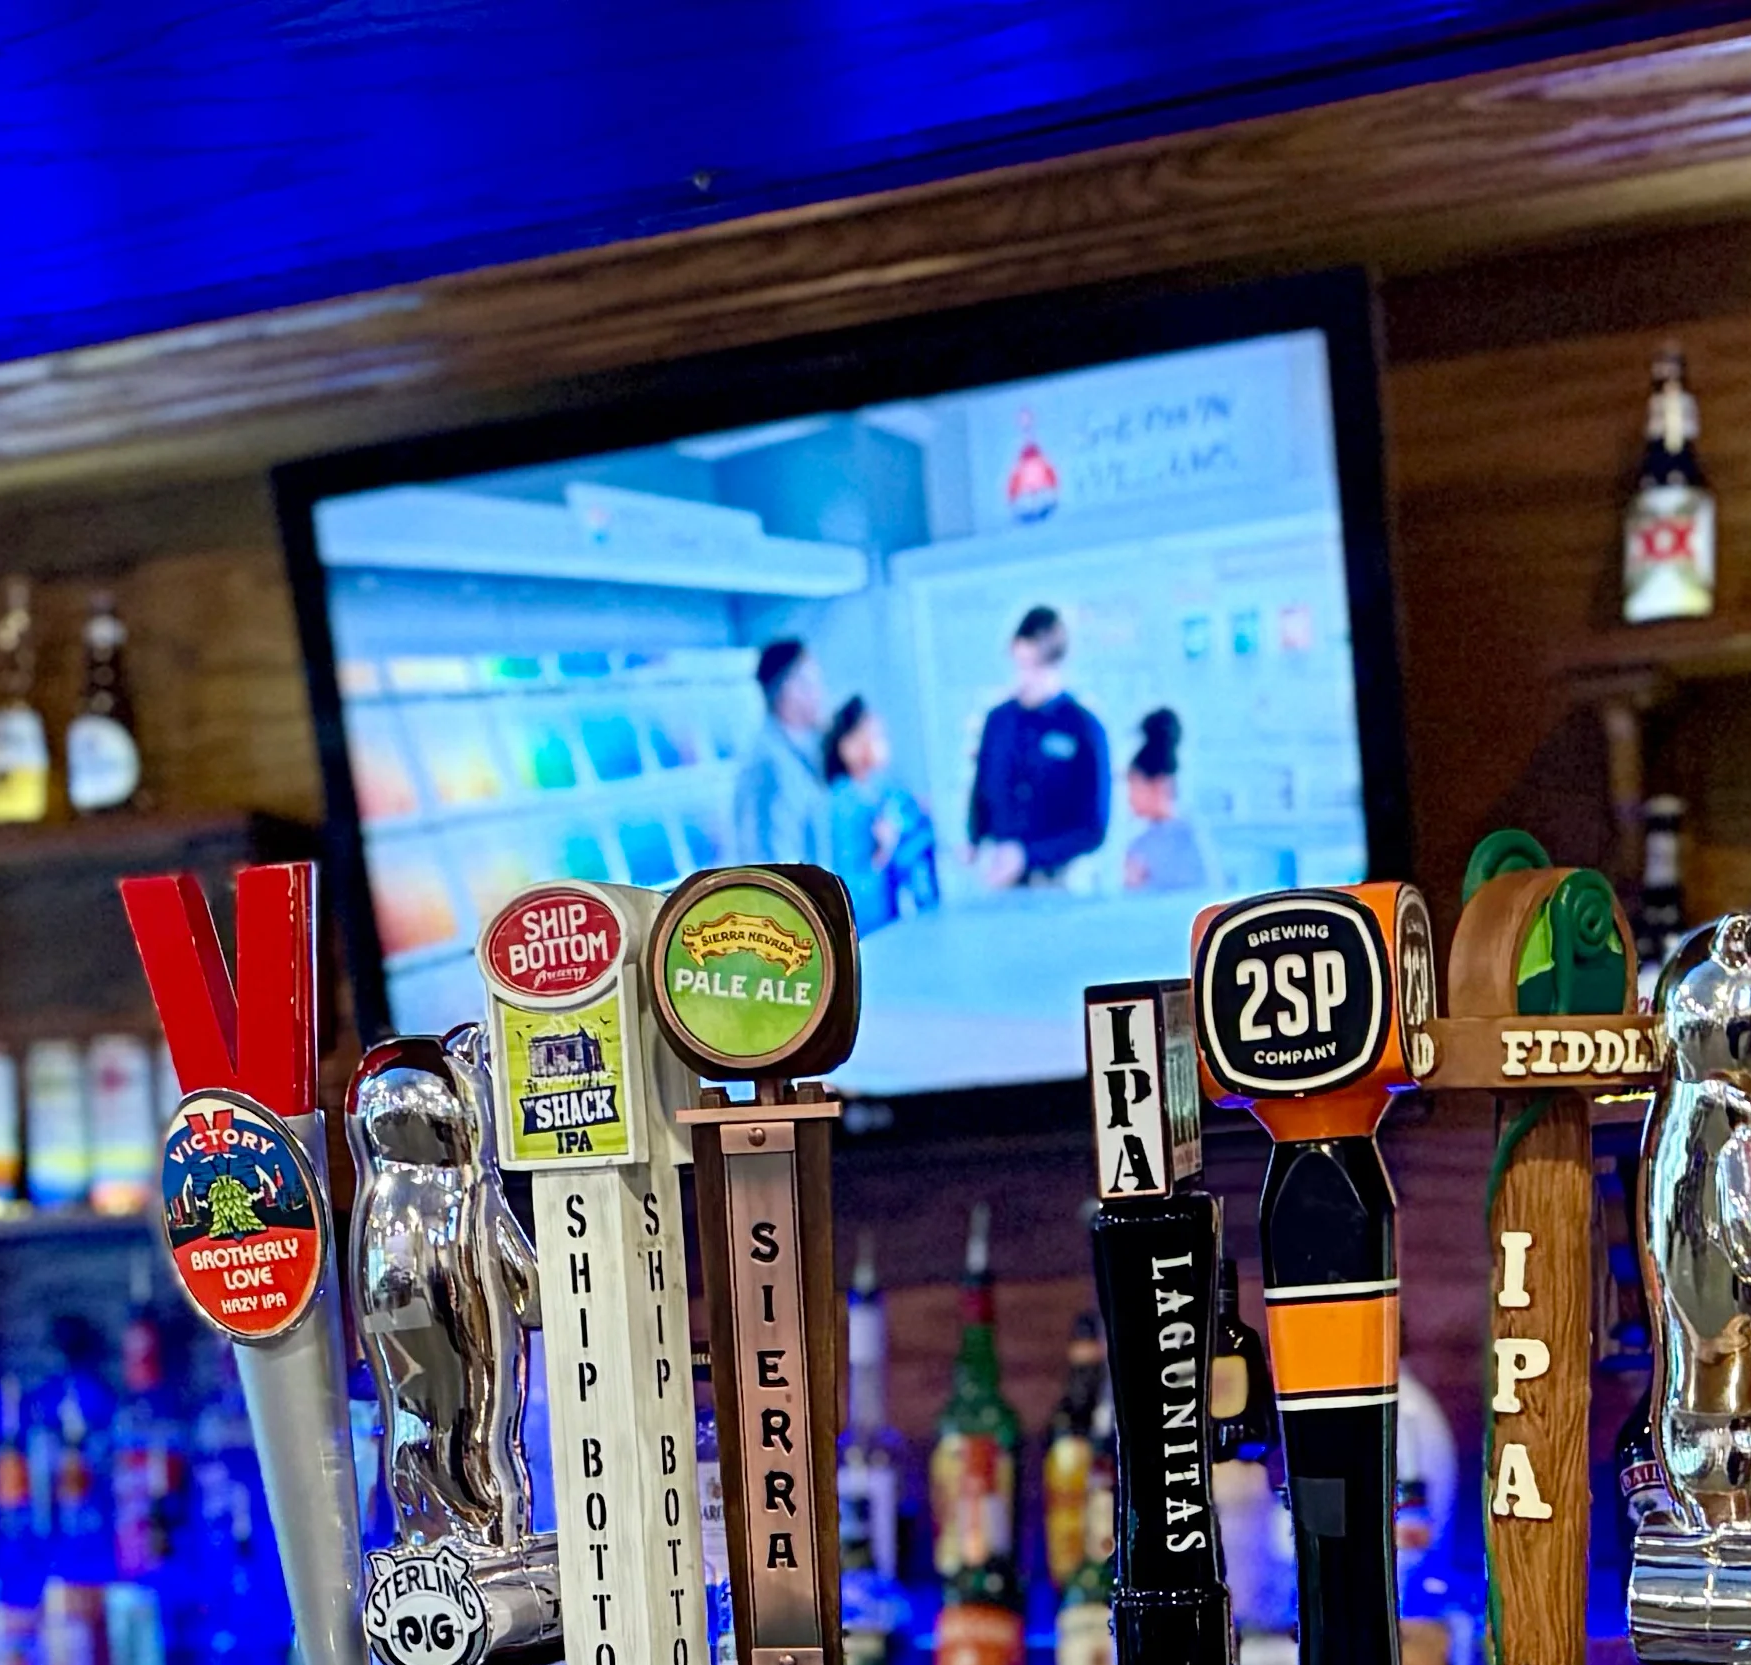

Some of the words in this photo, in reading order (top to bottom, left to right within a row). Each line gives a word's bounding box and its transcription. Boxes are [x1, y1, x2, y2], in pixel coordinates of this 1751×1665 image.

[522, 903, 587, 942] SHIP
[1247, 923, 1330, 948] BREWING
[508, 930, 609, 976] BOTTOM
[701, 931, 745, 948] SIERRA
[748, 931, 794, 956] NEVADA
[674, 967, 748, 999] PALE
[755, 977, 812, 1007] ALE
[1235, 949, 1348, 1042] 2SP
[1253, 1041, 1337, 1066] COMPANY
[534, 1088, 614, 1130] SHACK
[1103, 1004, 1159, 1194] IPA
[169, 1128, 275, 1165] VICTORY
[555, 1131, 594, 1155] IPA
[190, 1237, 300, 1272] BROTHERLY
[222, 1265, 275, 1291] LOVE
[565, 1194, 598, 1402] SHIP
[643, 1192, 672, 1399] SHIP
[221, 1295, 259, 1315] HAZY
[262, 1292, 288, 1311] IPA
[750, 1221, 799, 1569] SIERRA
[1492, 1231, 1553, 1519] IPA
[1150, 1251, 1207, 1553] LAGUNITAS
[372, 1562, 477, 1628] STERLING
